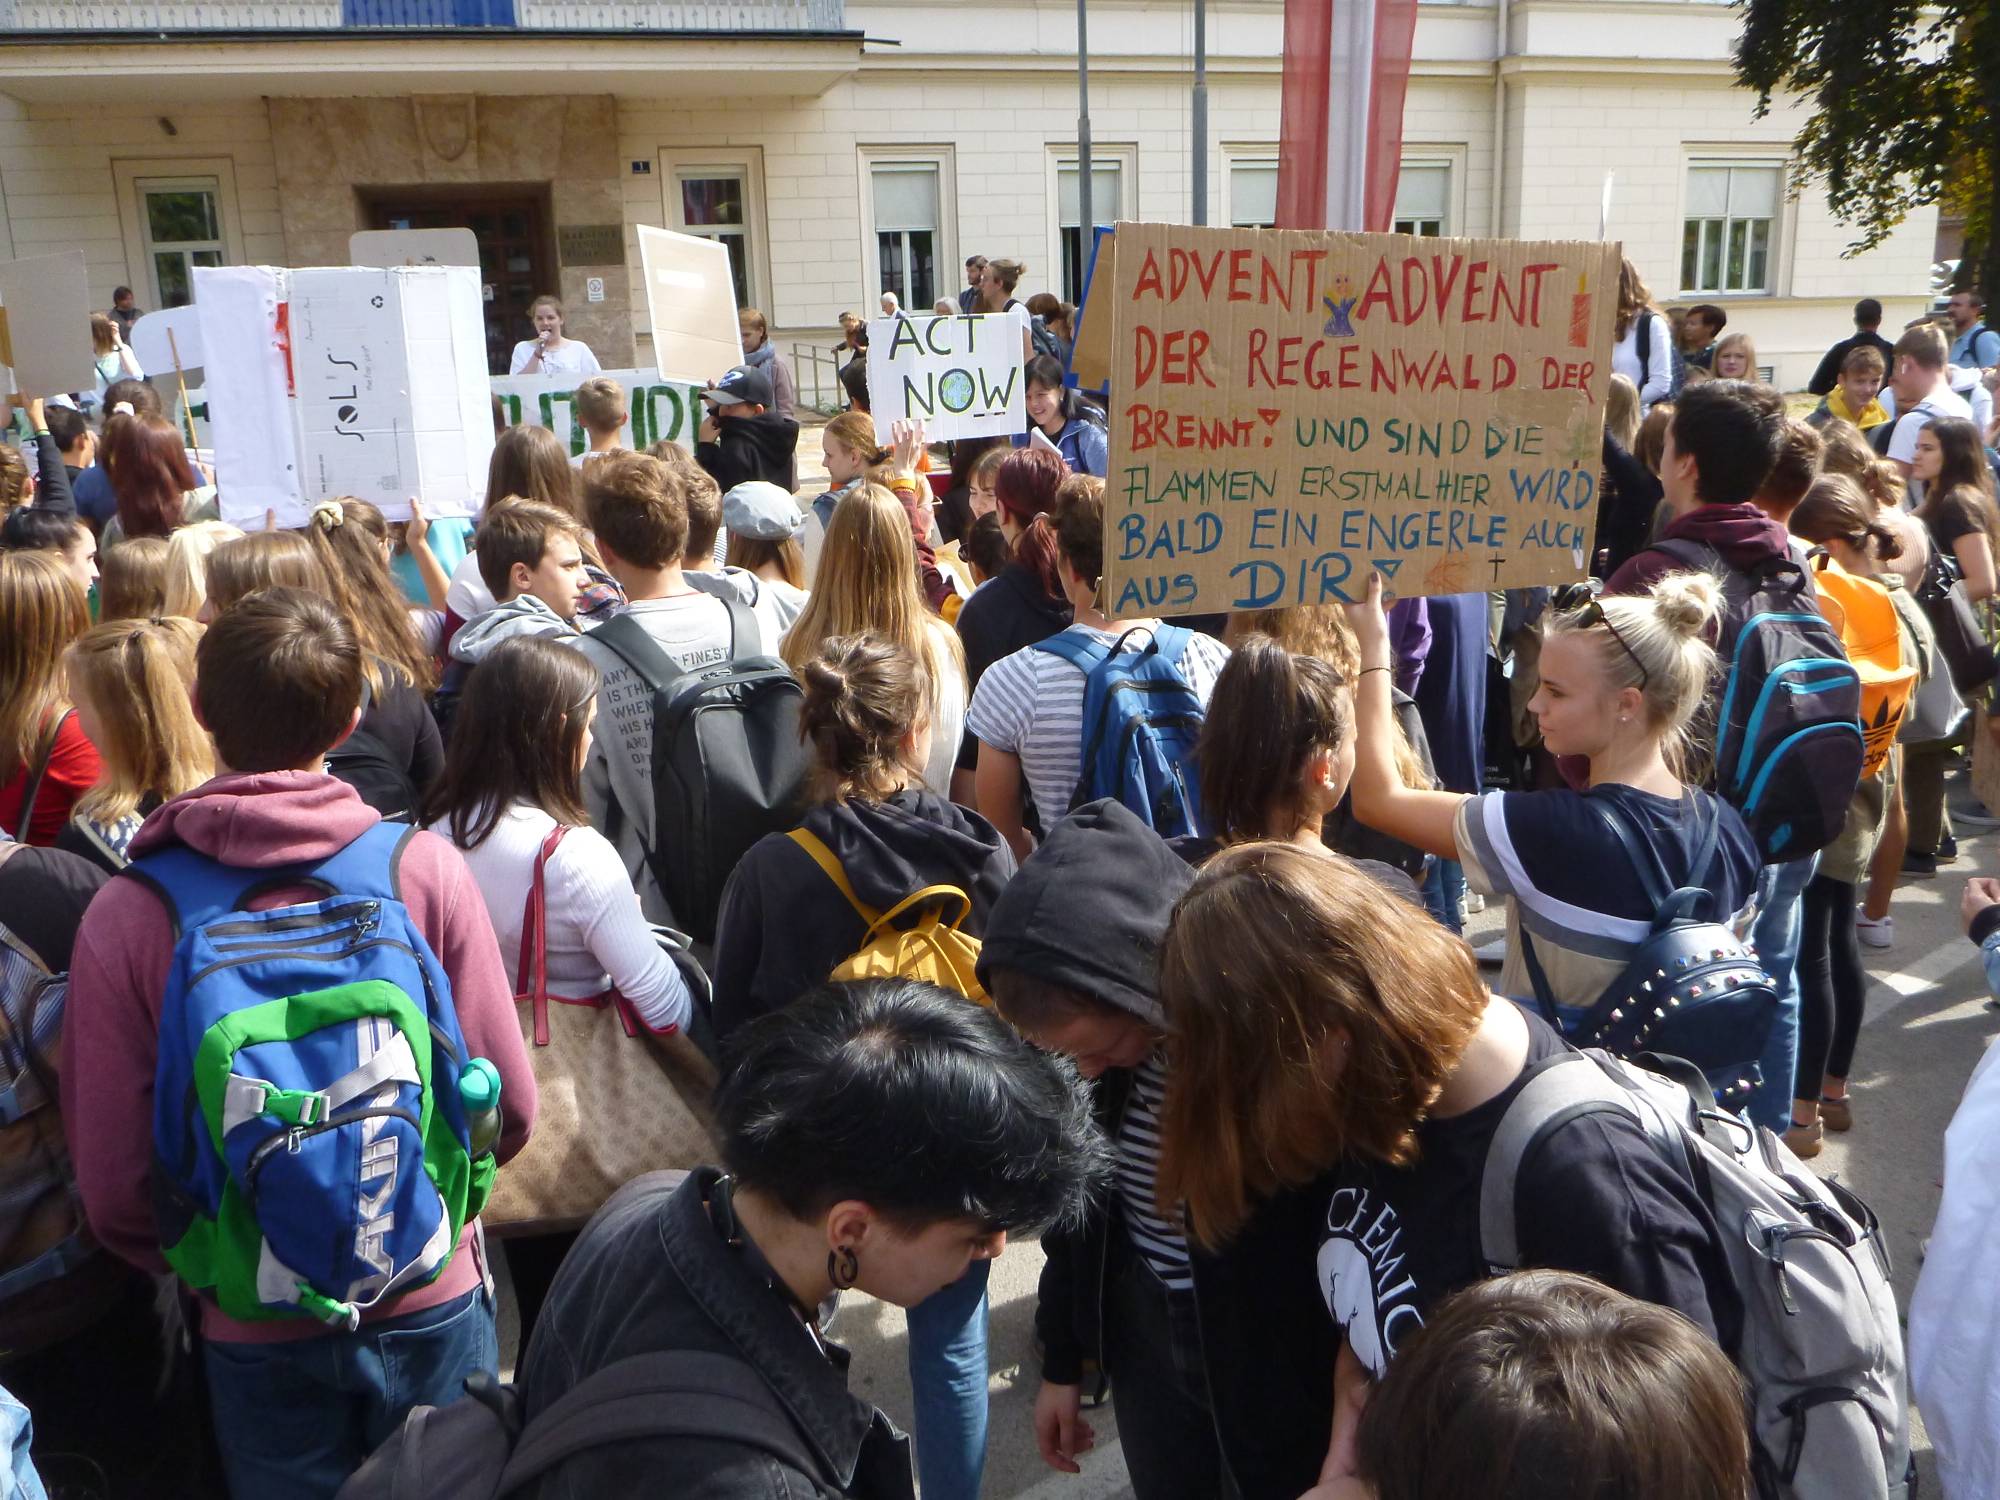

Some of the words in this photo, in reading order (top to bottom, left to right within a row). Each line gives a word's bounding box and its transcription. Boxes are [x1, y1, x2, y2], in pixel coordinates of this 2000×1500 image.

[1132, 248, 1328, 313] ADVENT
[1355, 255, 1560, 328] ADVENT
[888, 314, 985, 361] ACT
[1134, 325, 1216, 390] DER
[1248, 328, 1517, 395] REGENWALD
[1537, 356, 1595, 404] DER
[902, 367, 1017, 419] NOW
[1296, 417, 1369, 451] UND
[1384, 417, 1471, 458] SIND
[1485, 421, 1544, 459] DIE
[1122, 464, 1277, 507] FLAMMEN
[1510, 467, 1593, 511] WIRD
[1118, 512, 1223, 560] BALD
[1249, 508, 1318, 549] EIN
[1341, 510, 1507, 553] ENGERLE
[1520, 519, 1585, 550] AUCH
[1115, 574, 1198, 613] AUS
[682, 648, 729, 665] FINEST
[603, 669, 628, 687] ANY
[607, 690, 621, 703] IS
[611, 701, 653, 719] WHEN
[619, 720, 641, 735] HIS
